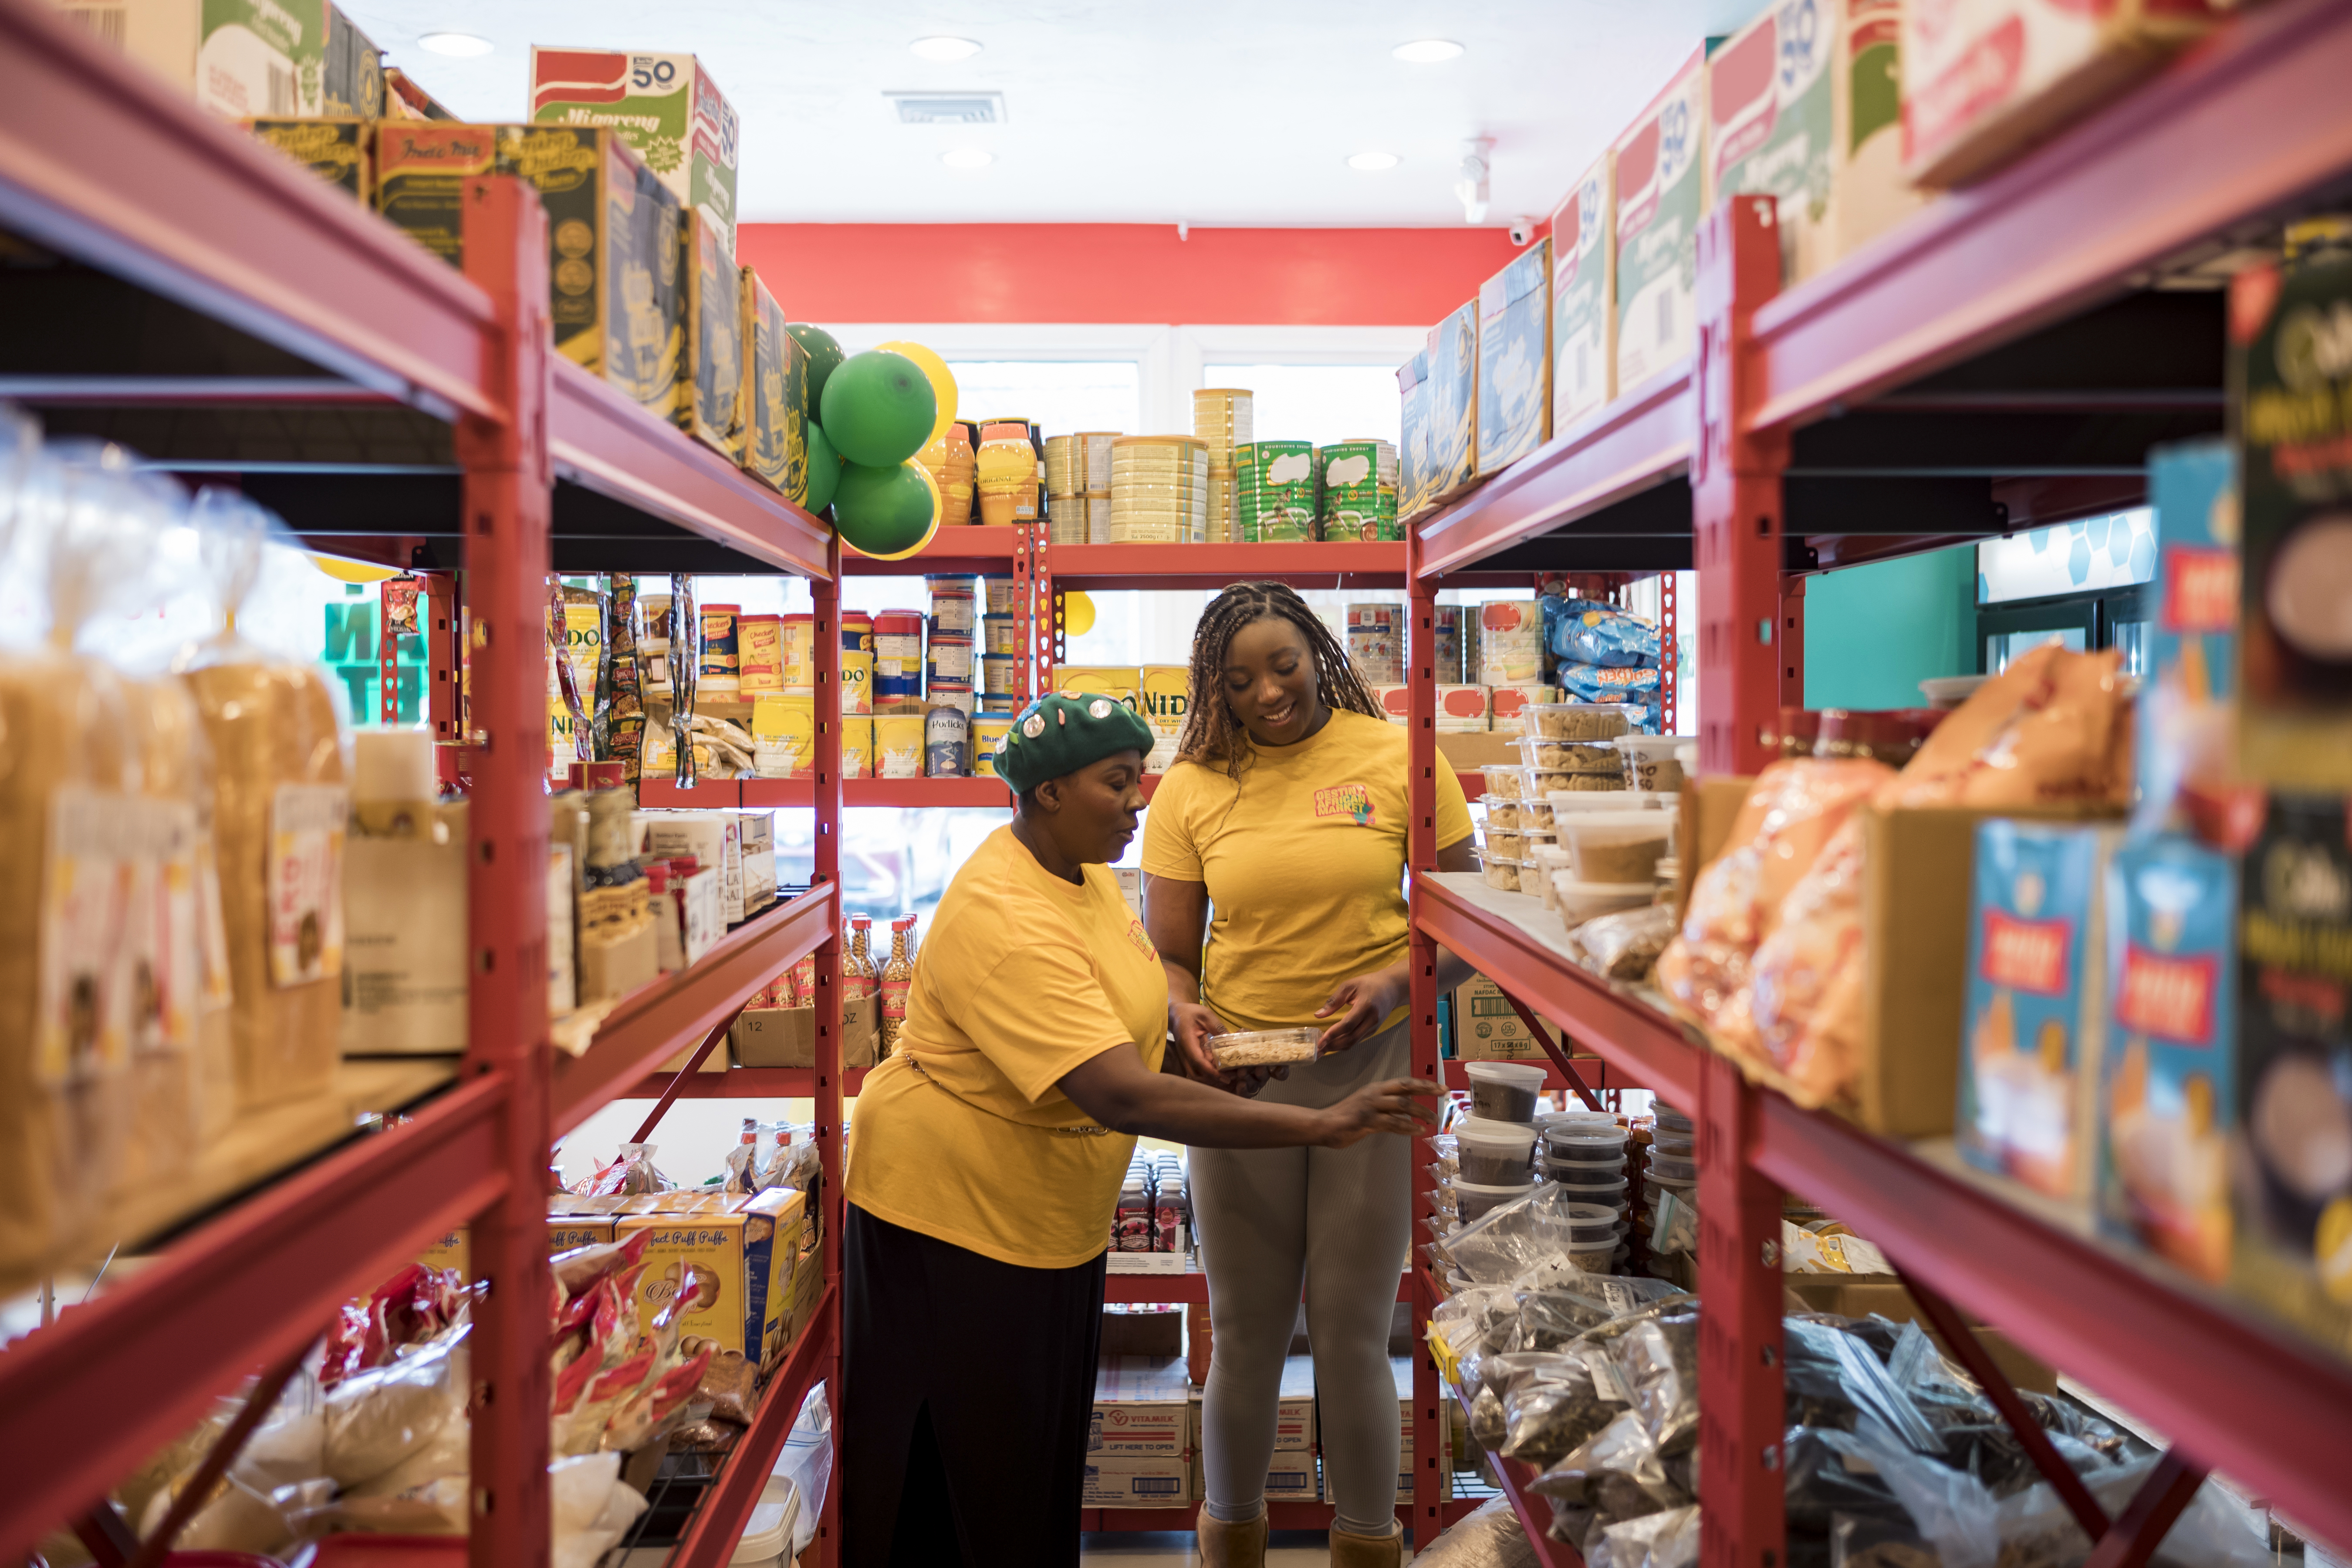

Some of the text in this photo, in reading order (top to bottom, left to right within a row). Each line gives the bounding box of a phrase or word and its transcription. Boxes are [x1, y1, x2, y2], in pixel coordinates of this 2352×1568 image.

[632, 60, 674, 89] 50
[703, 618, 730, 630] Checkers
[545, 627, 600, 647] NDO
[750, 629, 774, 639] Checkers
[755, 637, 774, 645] Custard
[616, 670, 634, 678] SpiCity
[842, 669, 865, 682] DO
[1597, 668, 1658, 687] GOLDEN
[1145, 692, 1186, 717] NID
[933, 720, 964, 730] Horlicks
[615, 734, 638, 743] SpiCity
[1316, 786, 1363, 800] DESTINY
[1317, 794, 1365, 808] AFRICAN
[1318, 803, 1364, 816] MARKET
[748, 1021, 762, 1031] 12
[568, 1230, 598, 1246] Puffs
[650, 1230, 729, 1247] fect Puff Puffs
